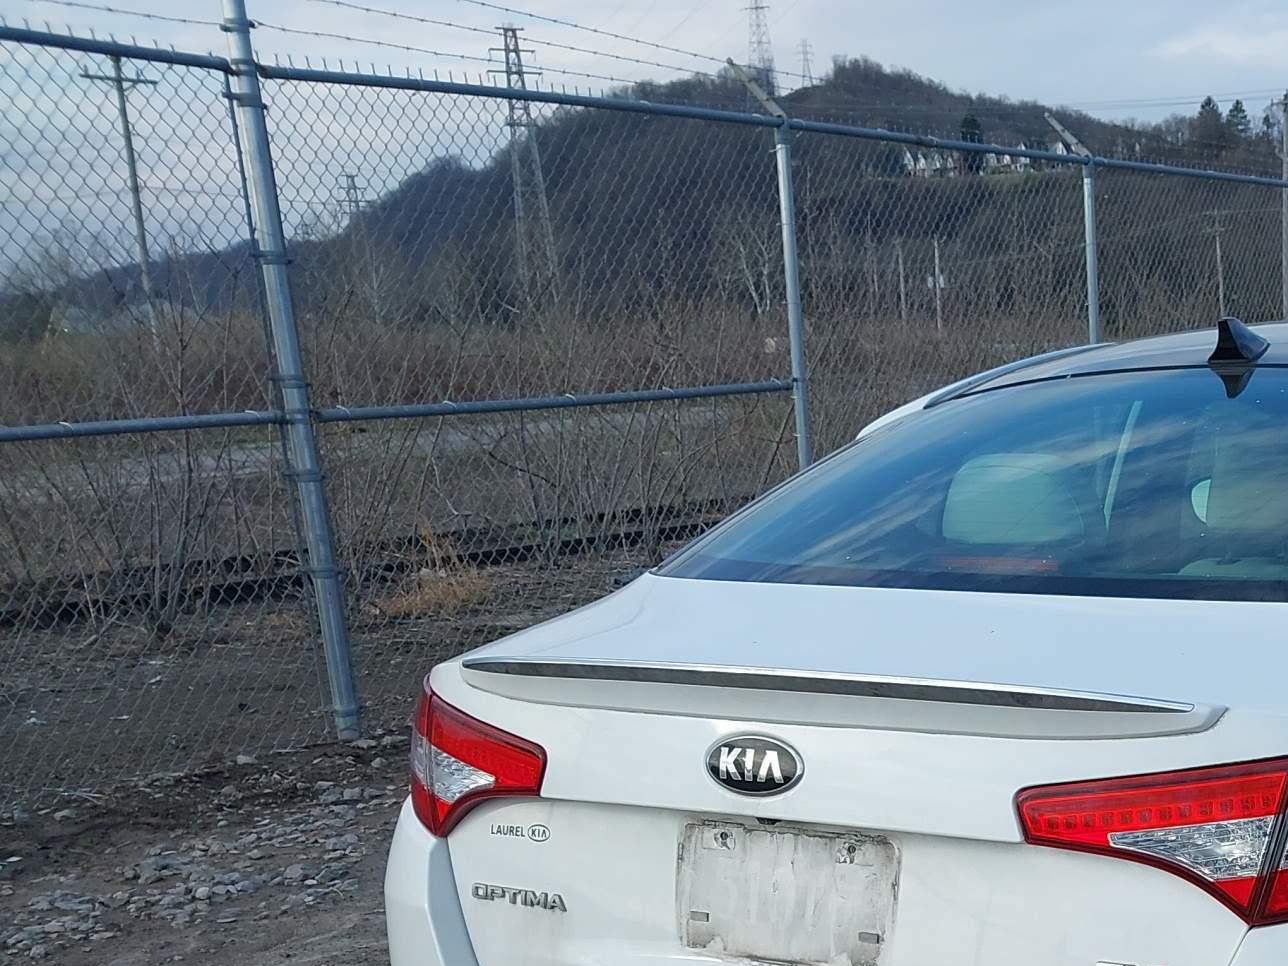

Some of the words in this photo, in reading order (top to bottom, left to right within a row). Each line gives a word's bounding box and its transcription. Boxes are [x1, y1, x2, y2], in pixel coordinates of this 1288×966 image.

[720, 747, 784, 783] KIA
[490, 823, 526, 838] LAUREL
[531, 828, 547, 838] KIA
[472, 882, 567, 912] OPTIMA
